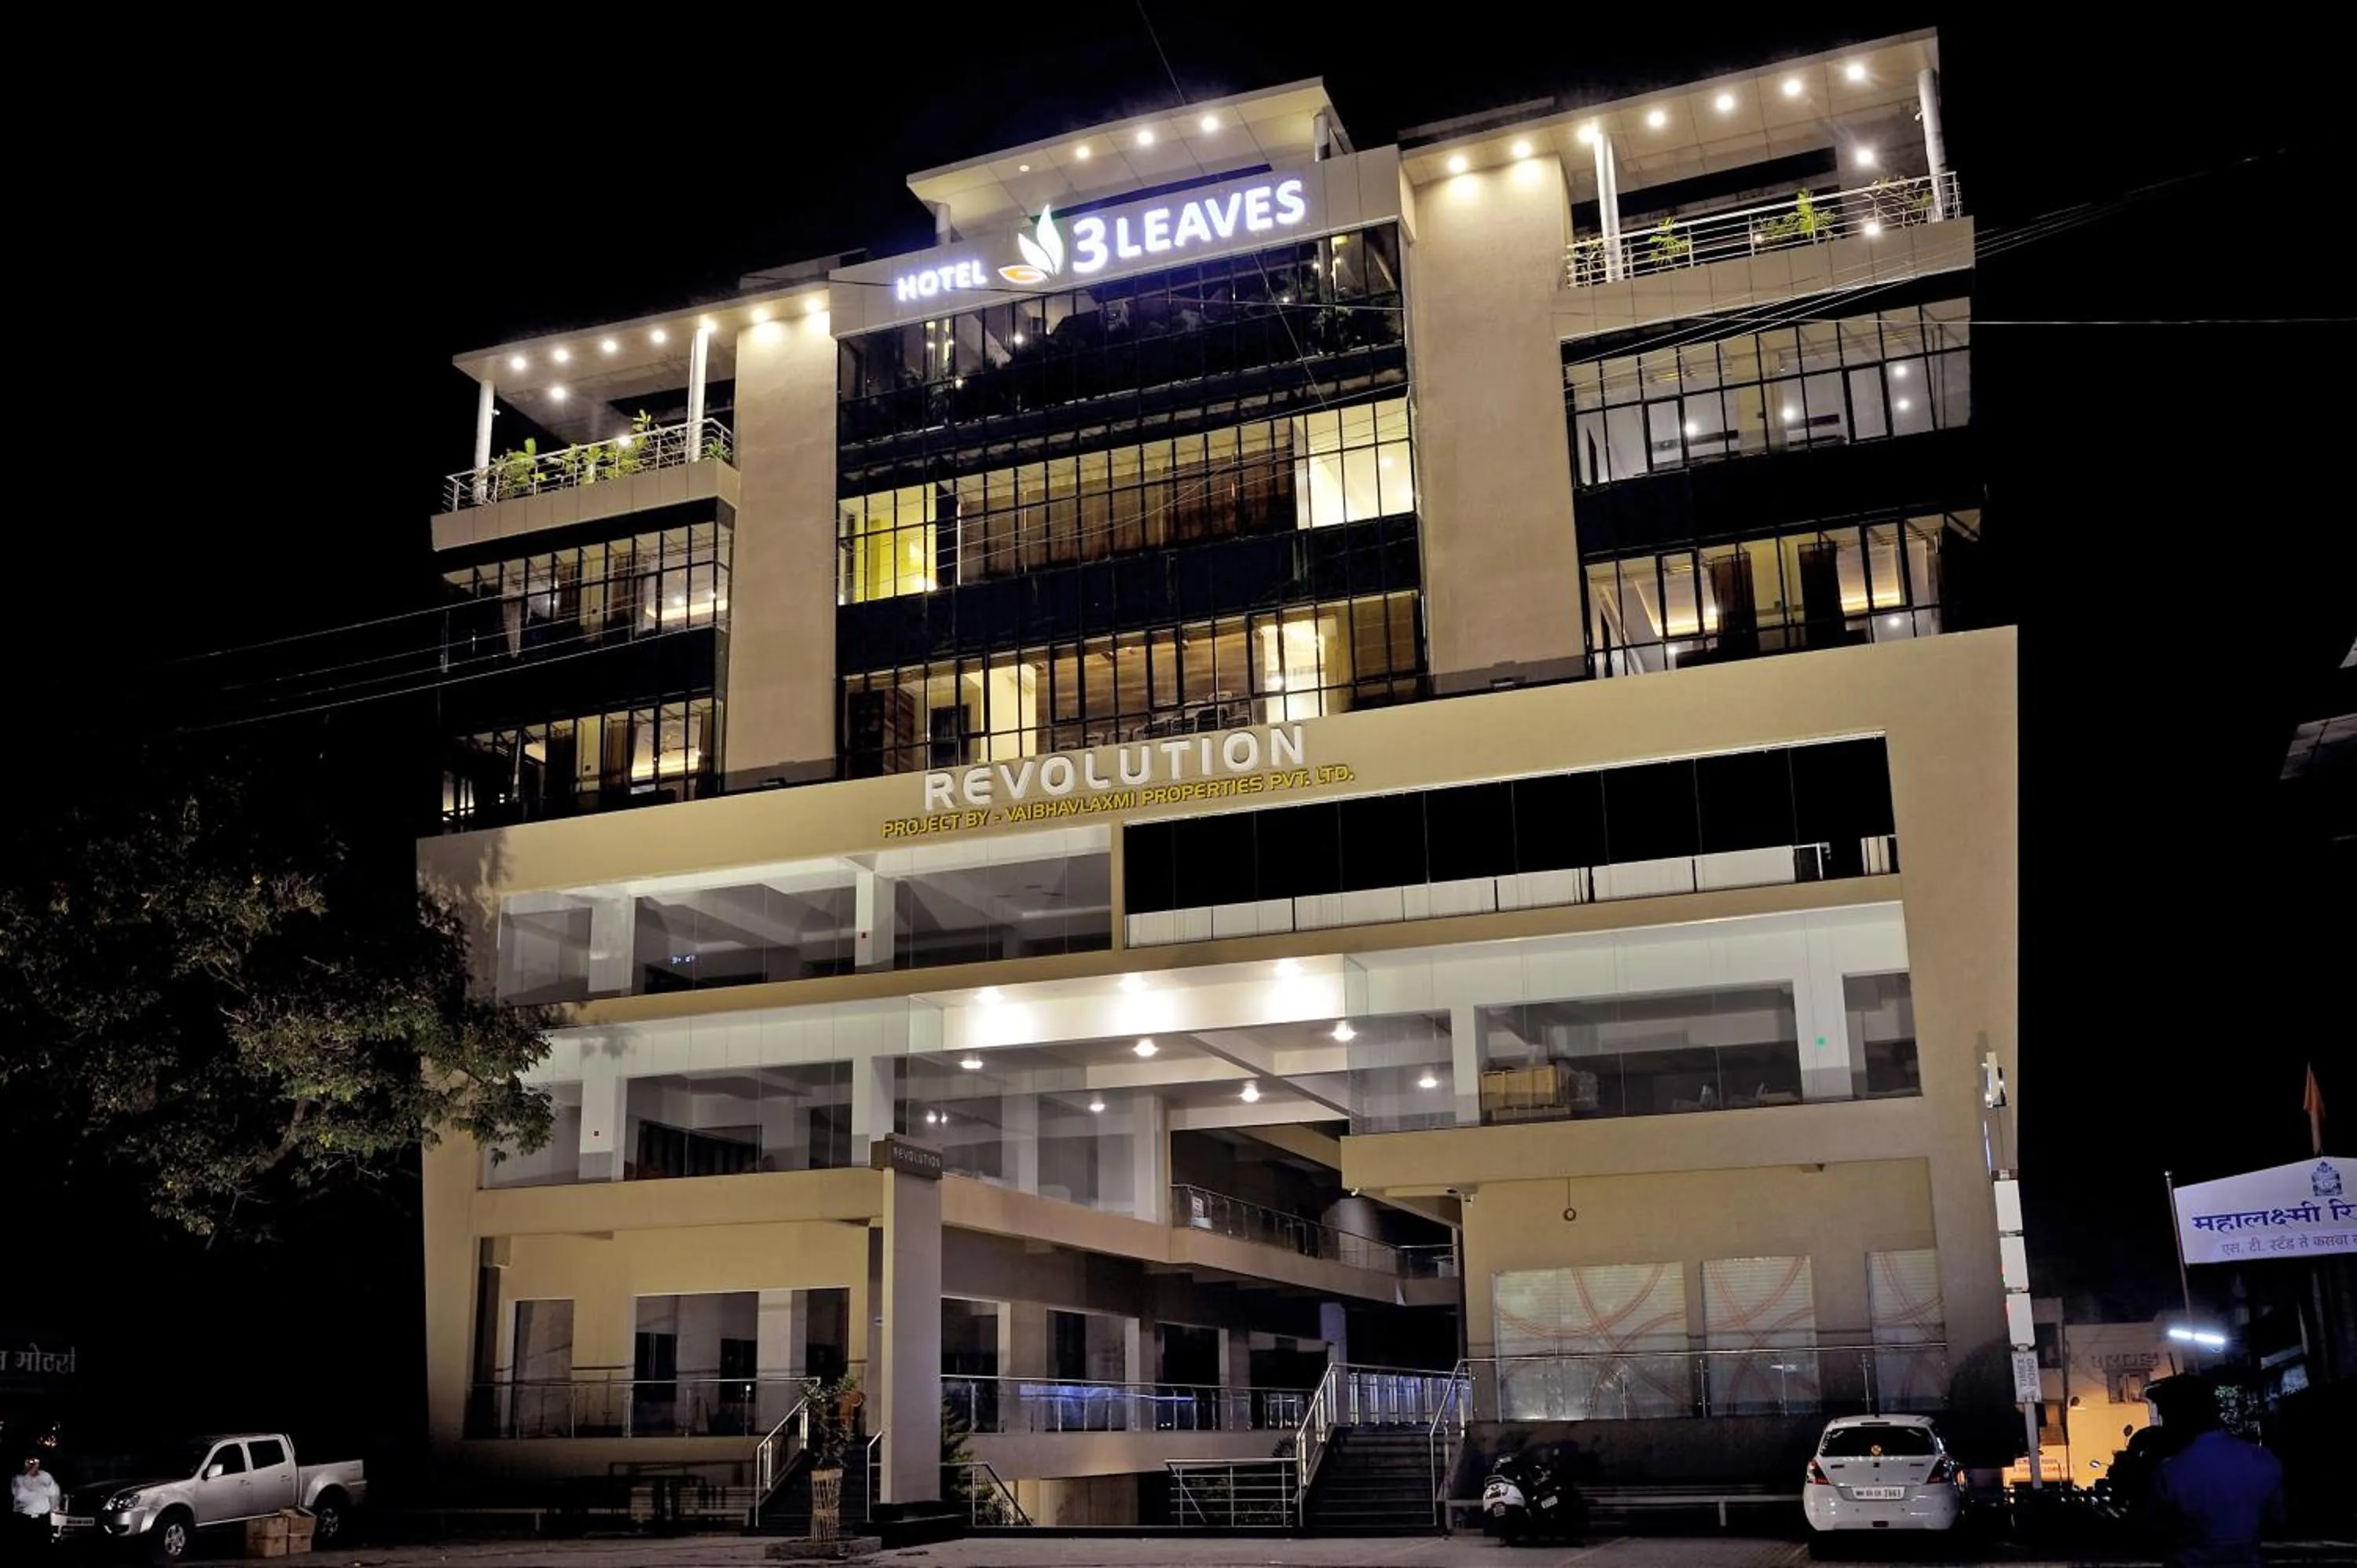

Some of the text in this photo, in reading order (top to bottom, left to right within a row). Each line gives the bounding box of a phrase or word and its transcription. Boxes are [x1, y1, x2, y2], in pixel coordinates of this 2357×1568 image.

[896, 260, 987, 302] HOTEL
[1116, 179, 1306, 258] LEAVES
[882, 812, 962, 837] PROJECT
[966, 810, 990, 828] BY
[1005, 789, 1137, 822] VAIBHAVLAXMI
[1141, 775, 1263, 806] PROPERTIES
[1270, 771, 1310, 790] PVT.
[1316, 764, 1355, 784] LTD.
[924, 725, 1305, 811] REVOLUTION
[2192, 1198, 2357, 1233] महालक्ष्मी रि
